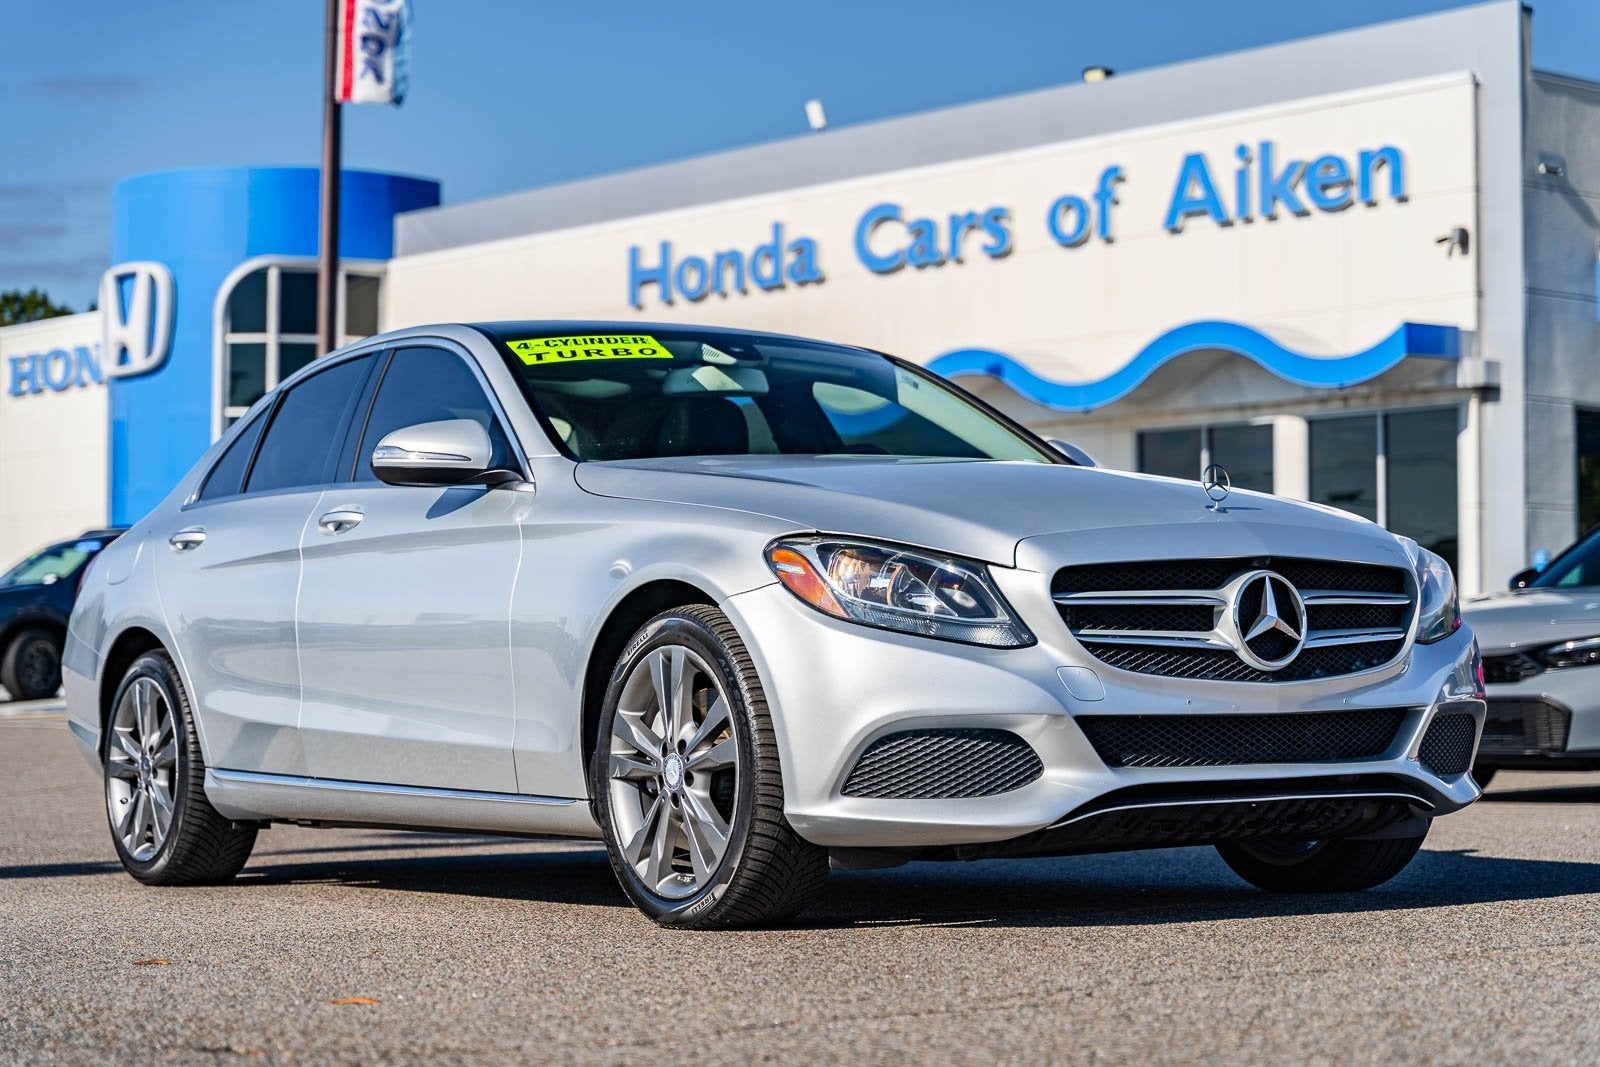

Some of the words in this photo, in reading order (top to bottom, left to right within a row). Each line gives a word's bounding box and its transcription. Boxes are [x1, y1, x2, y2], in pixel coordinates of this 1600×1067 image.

[628, 223, 824, 308] Honda
[854, 203, 1012, 274] Cars
[1047, 164, 1126, 248] of
[1164, 141, 1409, 233] Aiken
[515, 336, 648, 350] 4-CYLINDER
[527, 347, 658, 361] TURBO
[626, 631, 650, 657] PIRELLI
[690, 891, 717, 915] PIRELLI
